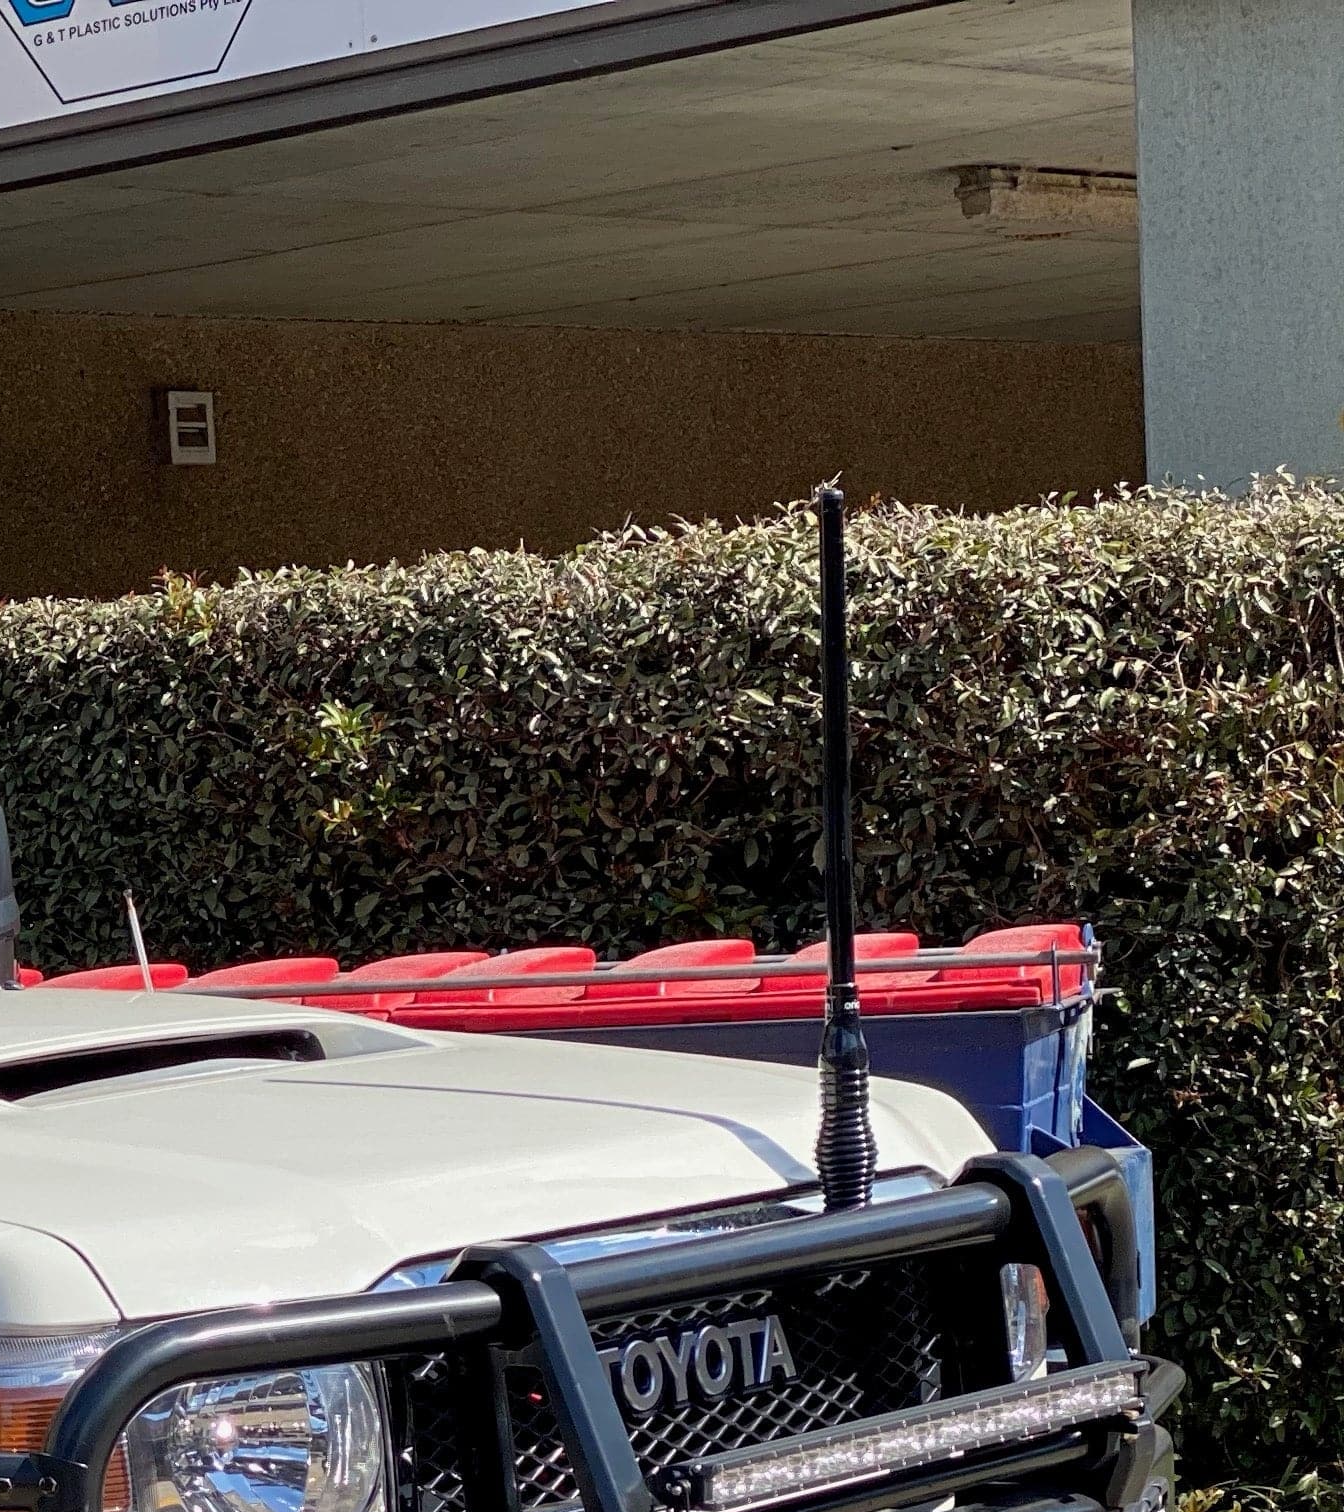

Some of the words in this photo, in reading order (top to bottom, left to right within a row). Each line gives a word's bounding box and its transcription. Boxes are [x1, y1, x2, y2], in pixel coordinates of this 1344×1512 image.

[33, 34, 43, 47] G
[46, 31, 55, 45] &
[58, 29, 66, 42] T
[69, 17, 121, 40] PLASTIC
[124, 1, 197, 27] SOLUTIONS
